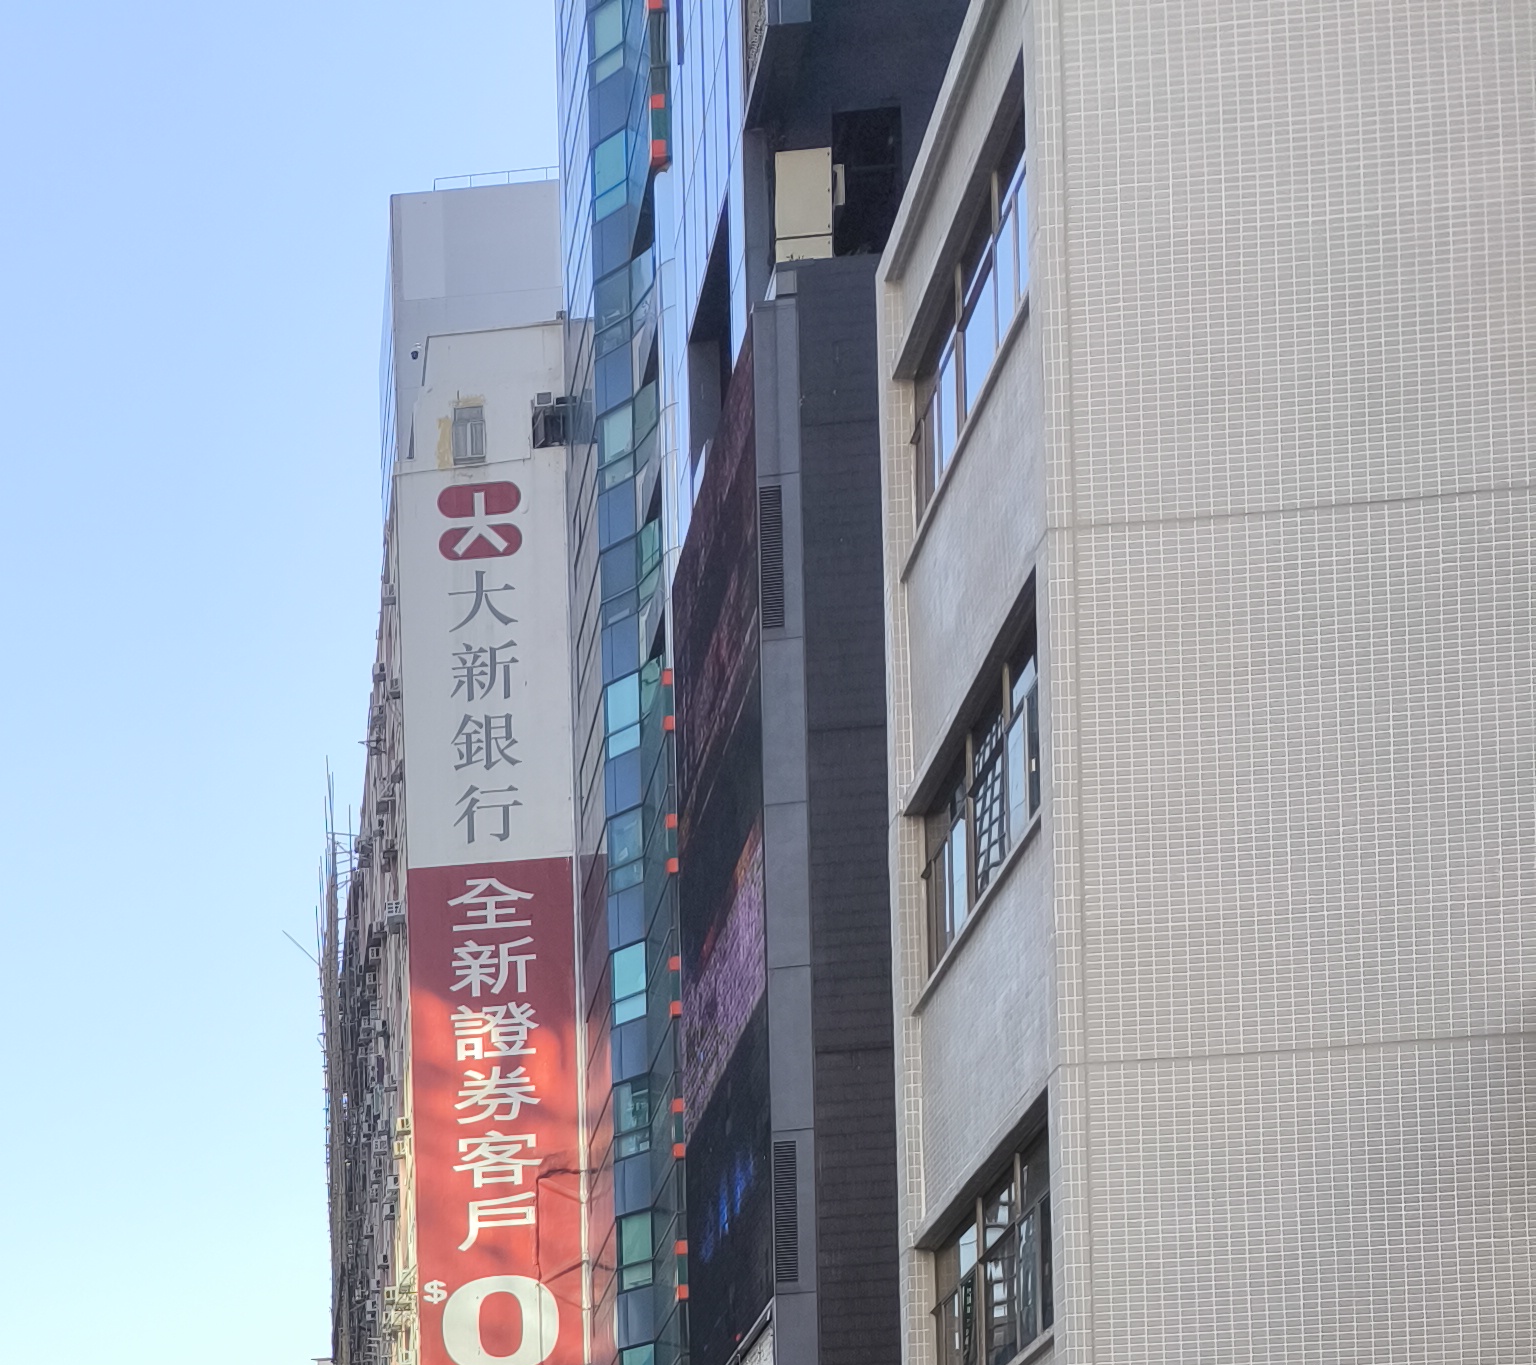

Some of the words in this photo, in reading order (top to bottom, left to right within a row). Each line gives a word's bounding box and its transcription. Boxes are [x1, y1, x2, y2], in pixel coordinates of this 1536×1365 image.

[448, 569, 522, 845] 大新銀行
[447, 878, 542, 1252] 全新證券客戶
